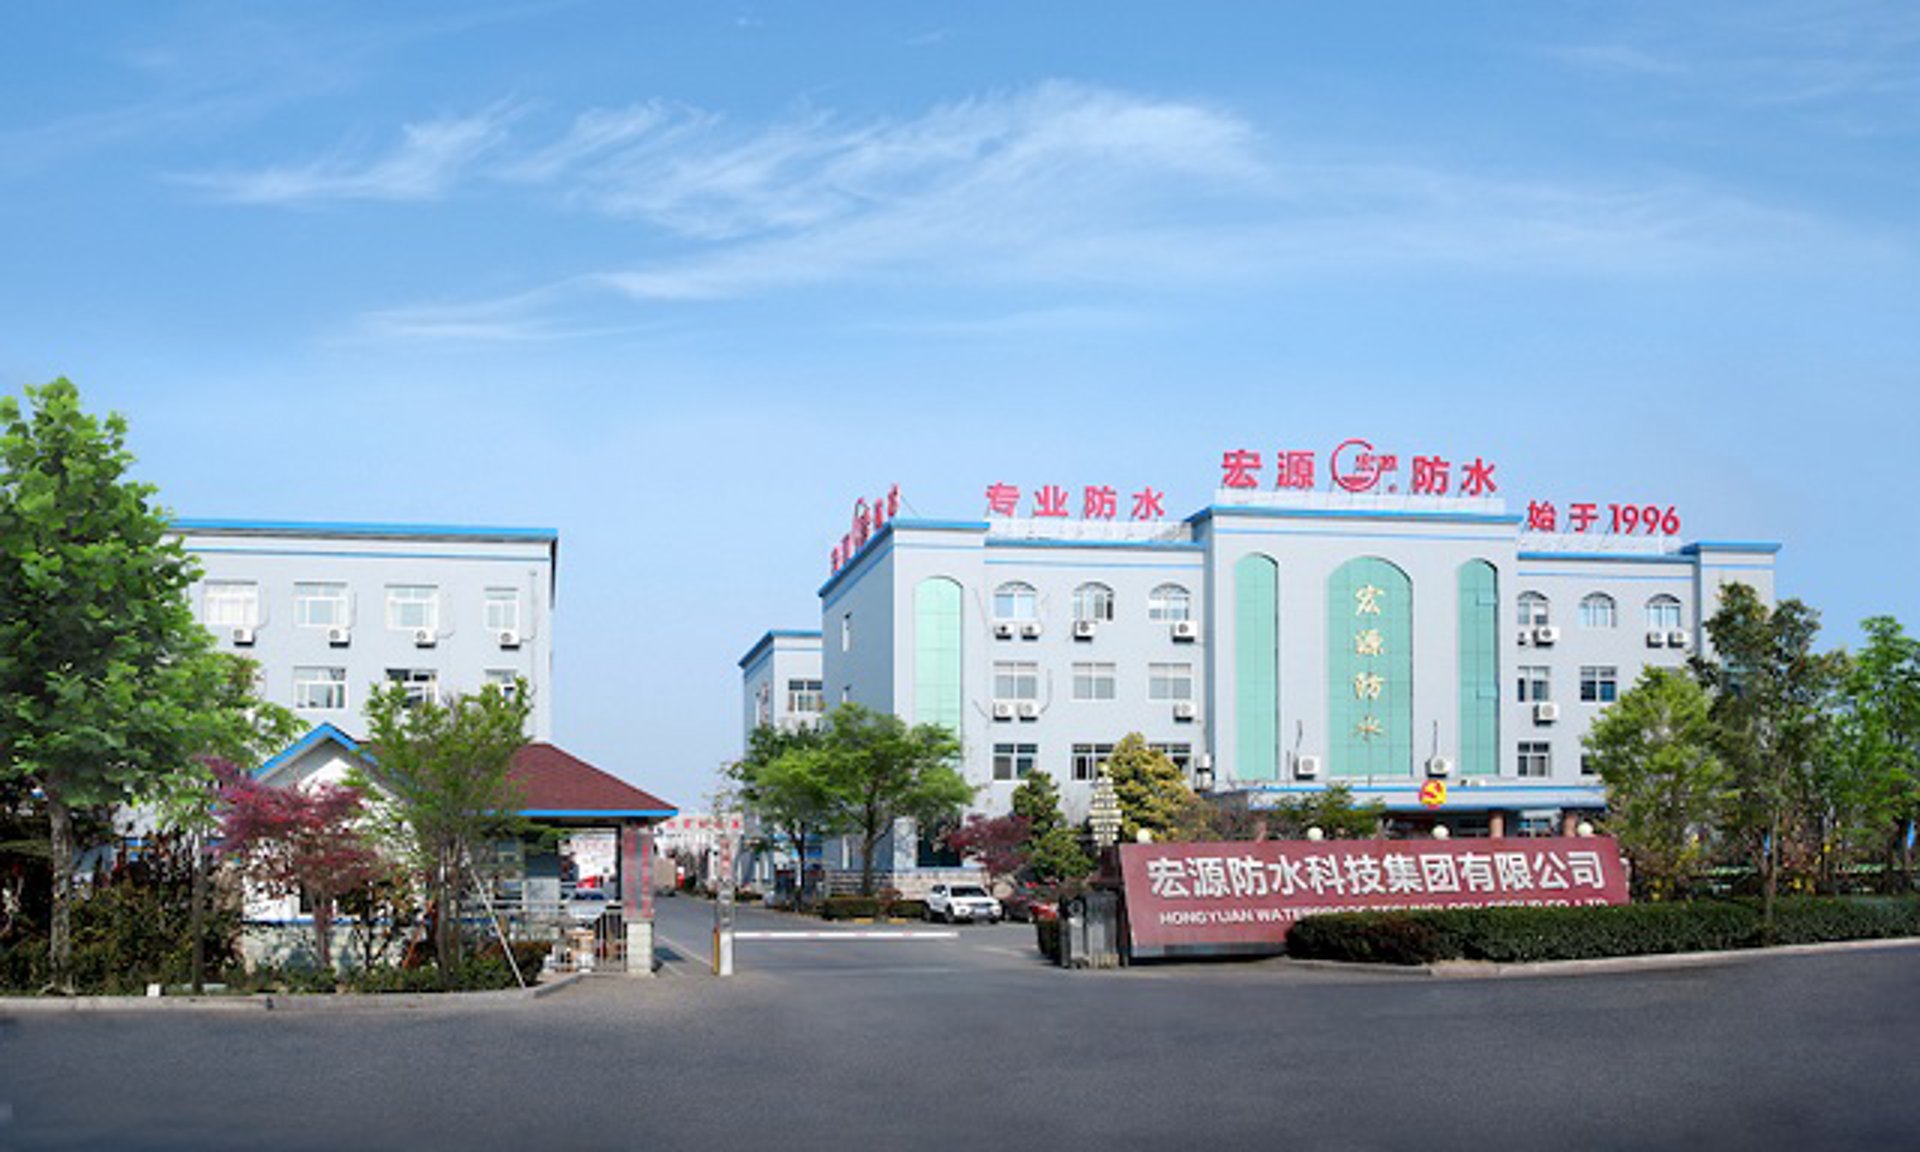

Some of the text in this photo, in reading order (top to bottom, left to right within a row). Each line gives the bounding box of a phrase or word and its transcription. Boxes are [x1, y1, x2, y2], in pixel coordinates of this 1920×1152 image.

[985, 481, 1165, 521] 专业防水
[1147, 852, 1606, 898] 宏源防水科技集团有限公司
